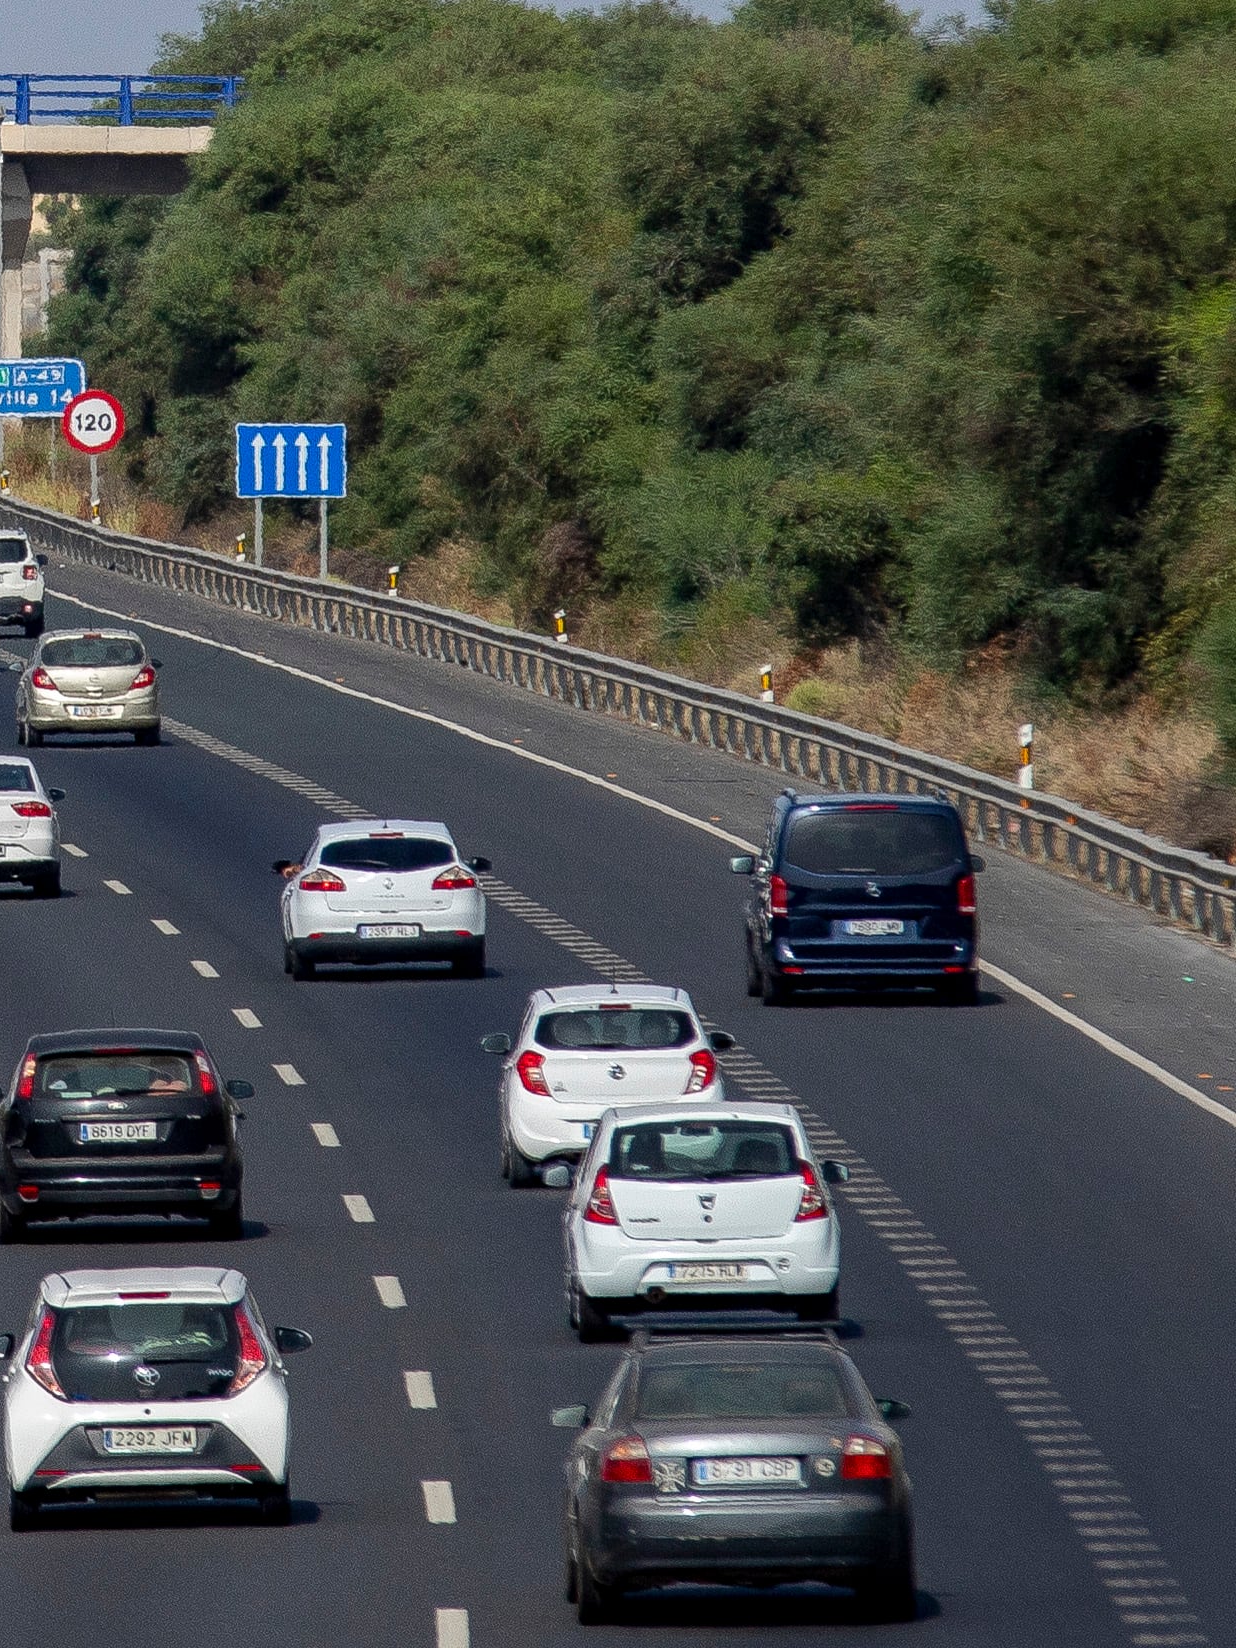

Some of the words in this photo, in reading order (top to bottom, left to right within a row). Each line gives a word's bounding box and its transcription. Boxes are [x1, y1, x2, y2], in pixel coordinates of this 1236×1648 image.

[17, 370, 62, 382] A-49
[74, 413, 112, 432] 120
[126, 1125, 150, 1138] DYF
[115, 1431, 156, 1447] 2292
[162, 1430, 193, 1446] JFM
